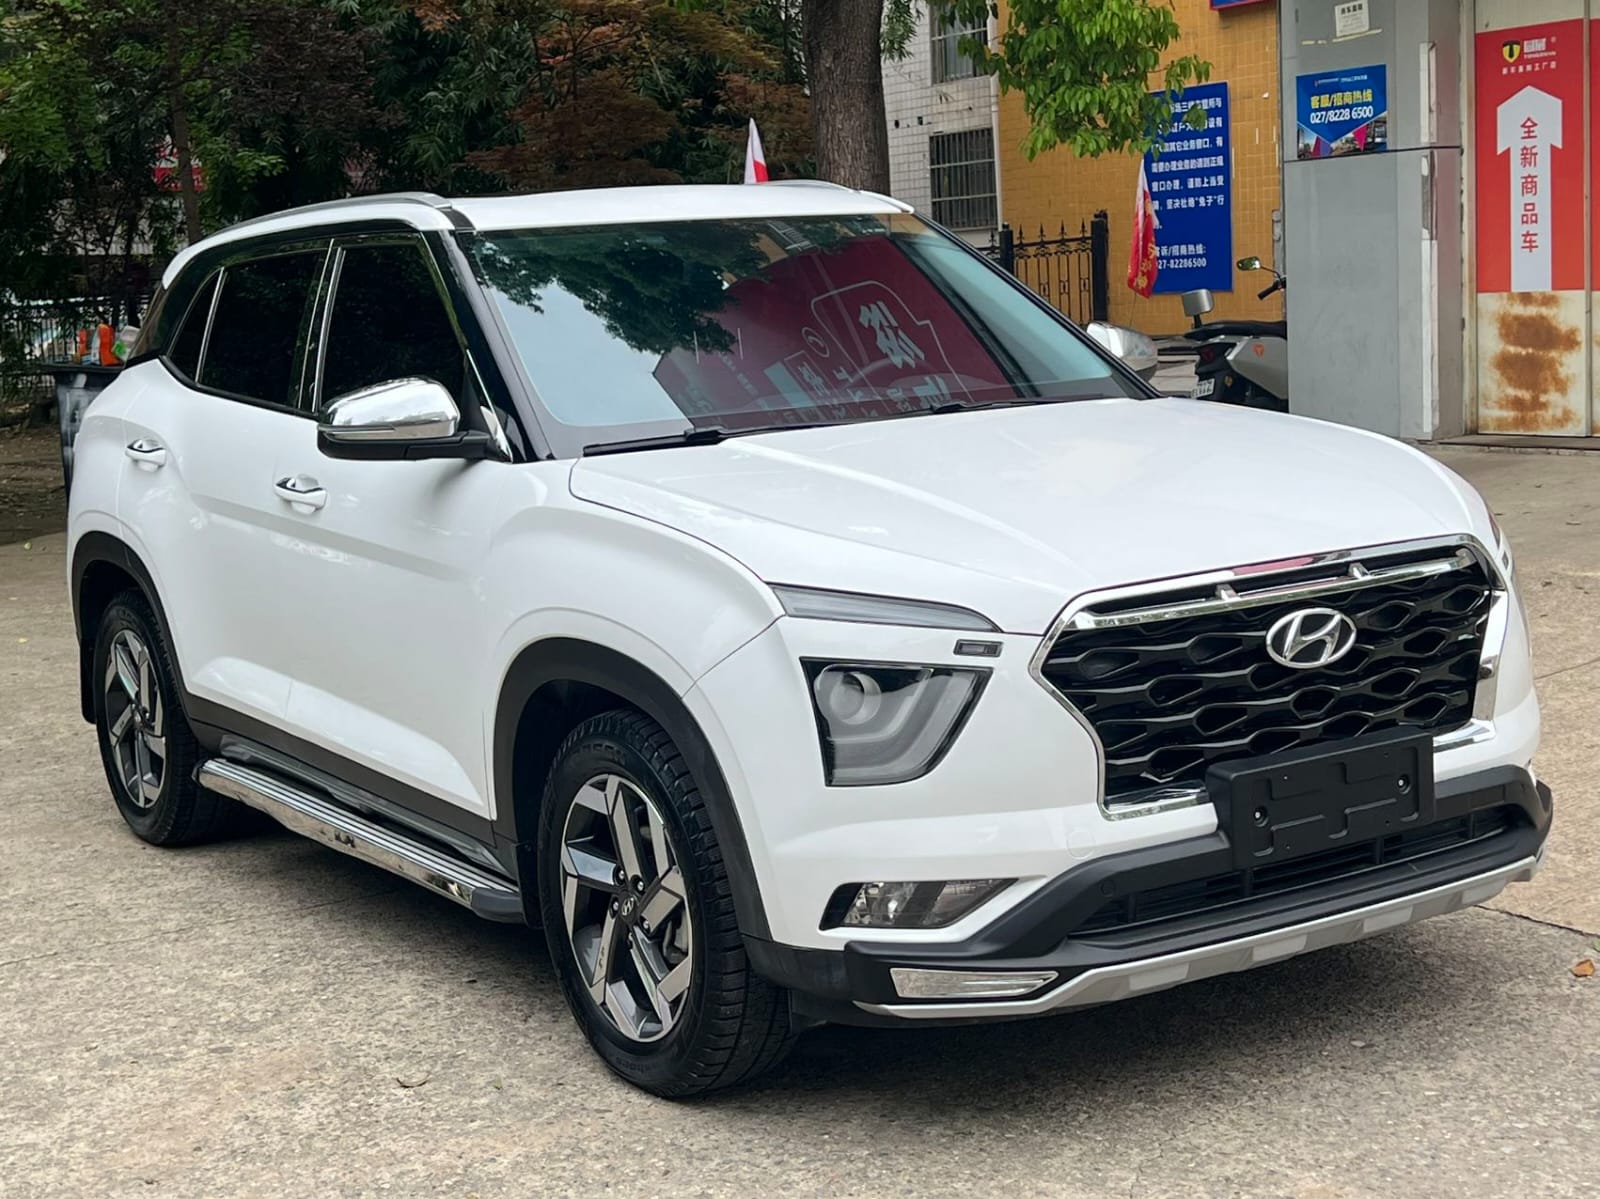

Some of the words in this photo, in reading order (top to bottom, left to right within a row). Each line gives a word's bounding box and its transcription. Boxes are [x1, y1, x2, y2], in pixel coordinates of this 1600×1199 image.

[1310, 108, 1351, 124] 027/8228
[1351, 105, 1374, 120] 6500
[1520, 116, 1539, 253] 全新商品车
[1157, 257, 1207, 270] 27-82286500
